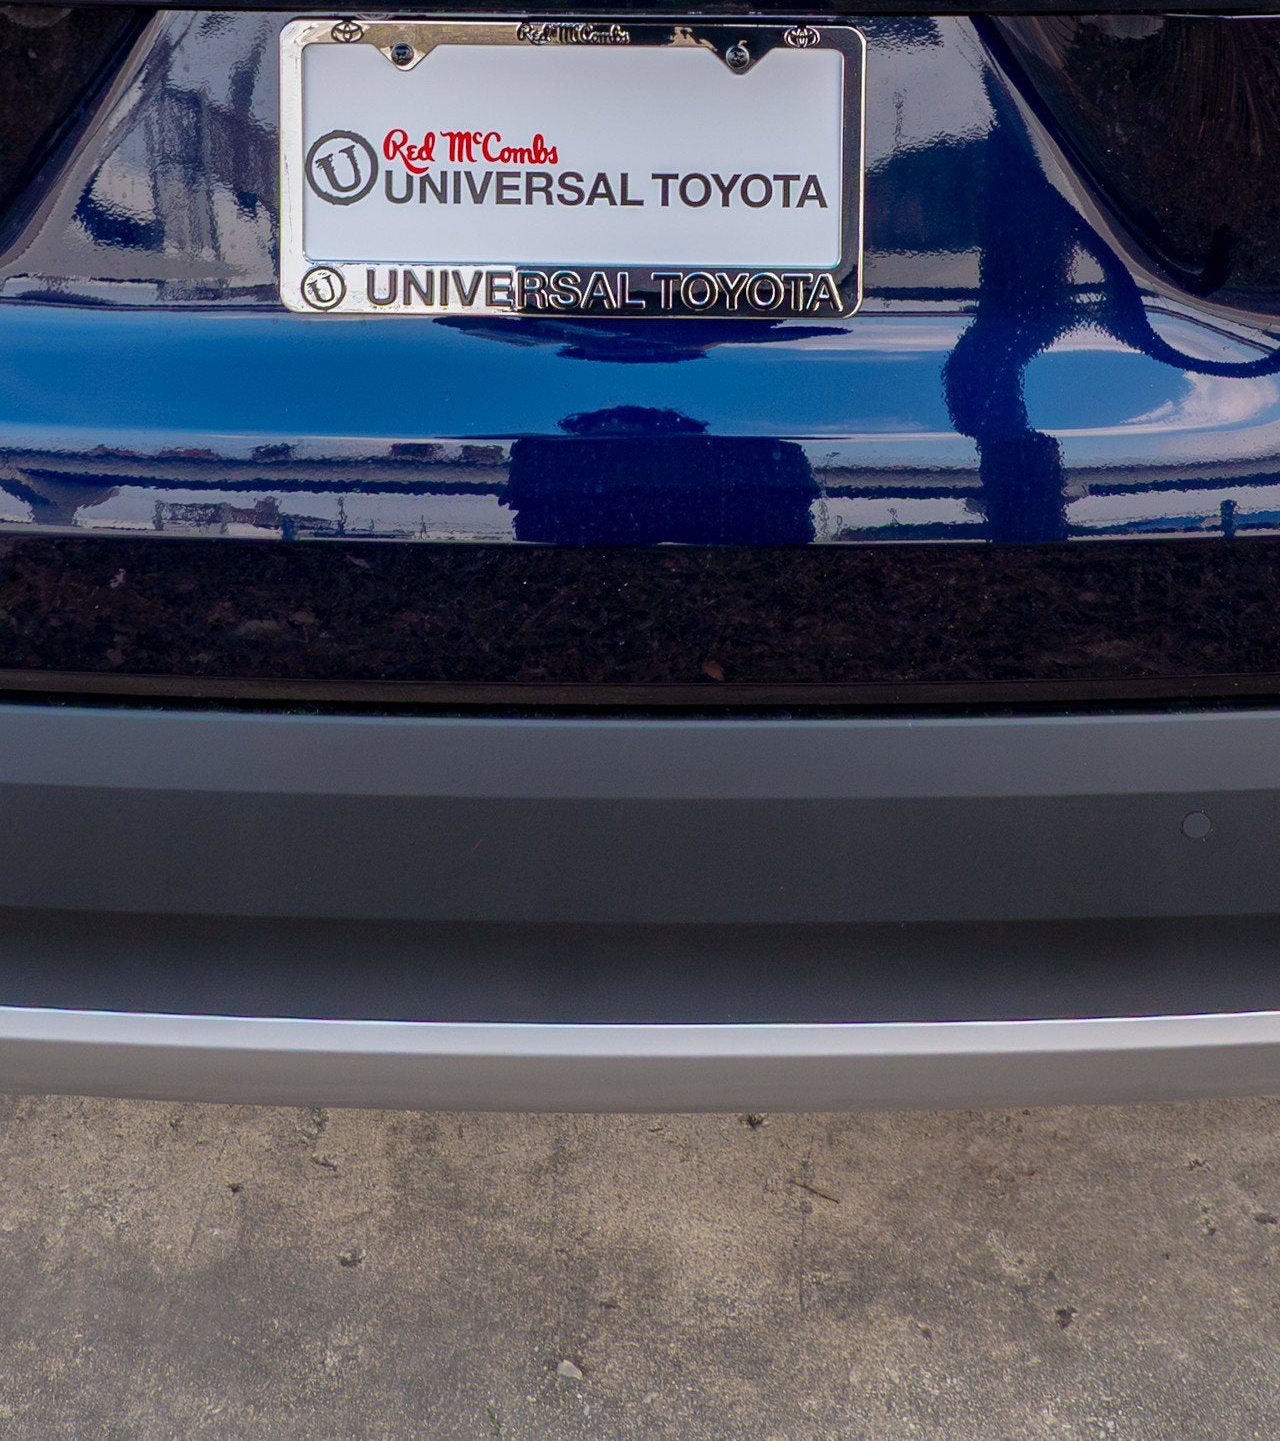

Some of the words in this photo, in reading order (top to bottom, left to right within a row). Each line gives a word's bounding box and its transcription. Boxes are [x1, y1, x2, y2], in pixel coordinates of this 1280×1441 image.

[516, 21, 551, 46] Red
[383, 128, 437, 175] Red
[439, 129, 559, 165] McCombs
[384, 169, 645, 207] UNIVERSAL
[651, 171, 829, 209] TOYOTA
[366, 268, 646, 311] UNIVERSAL
[650, 271, 844, 312] TOYOTA
